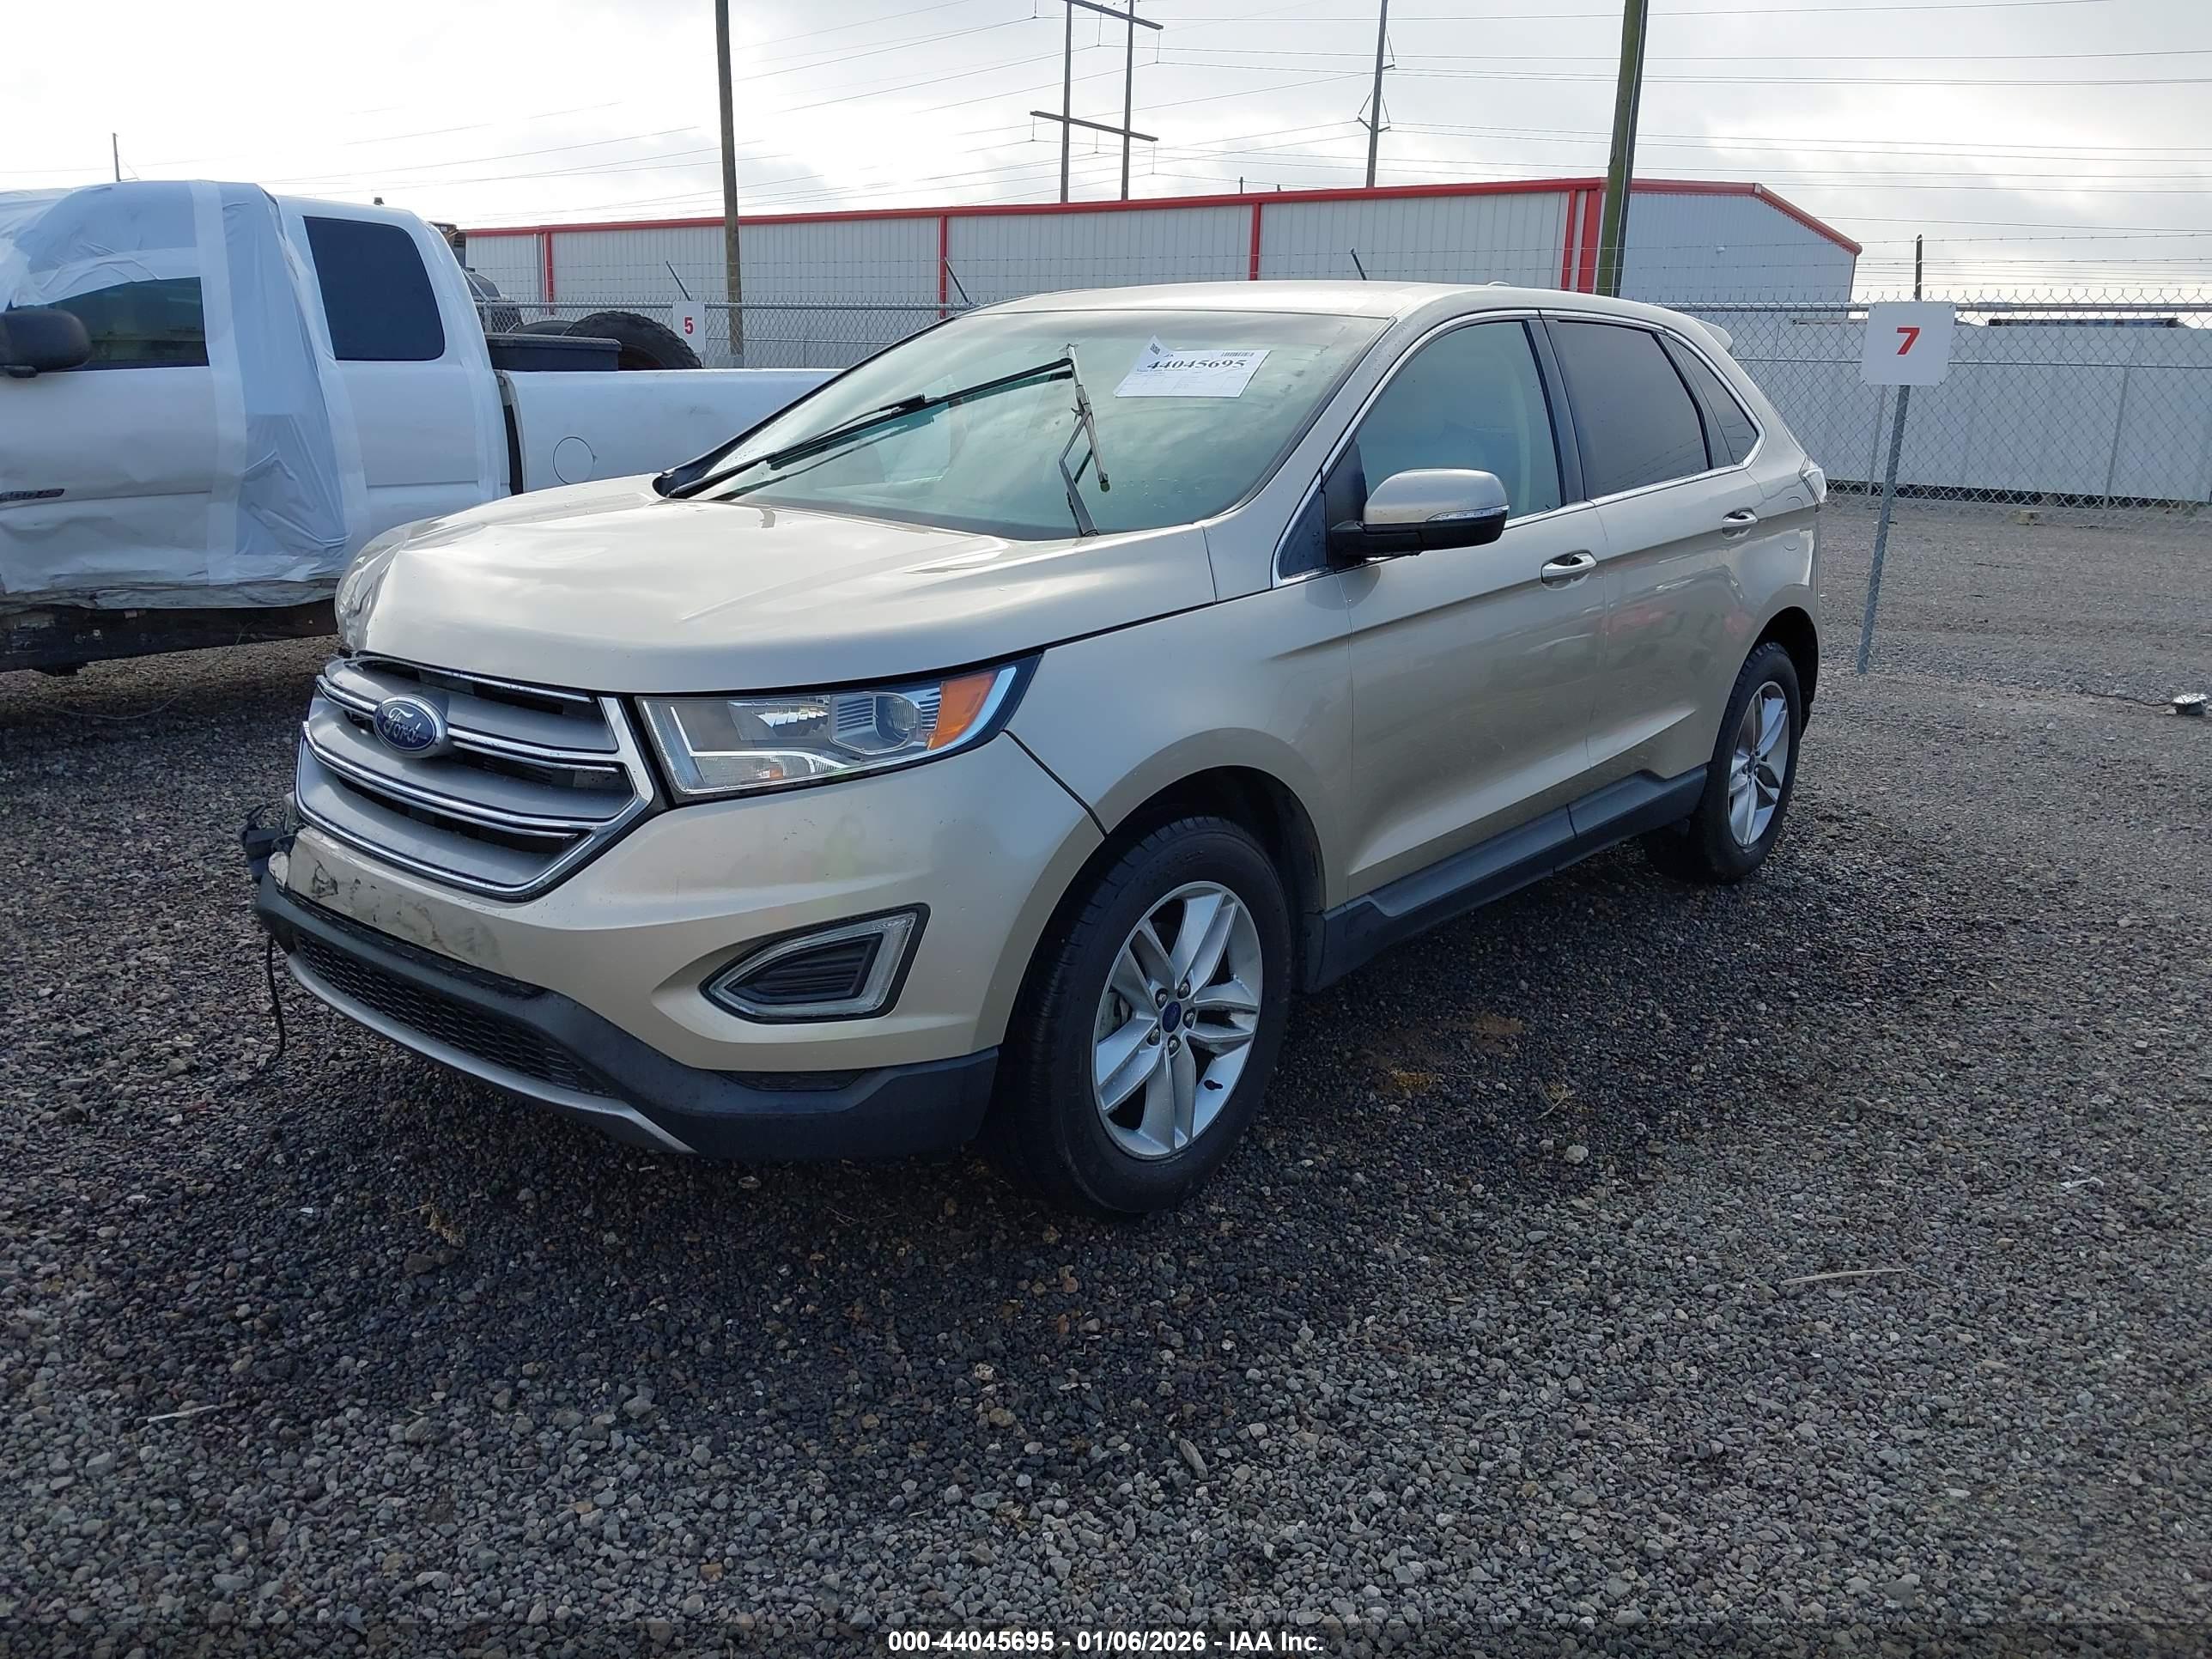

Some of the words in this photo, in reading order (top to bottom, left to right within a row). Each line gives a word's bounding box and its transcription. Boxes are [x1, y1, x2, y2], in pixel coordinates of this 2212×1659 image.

[684, 316, 694, 335] 5
[1896, 326, 1921, 356] 7
[1146, 359, 1248, 370] 44045695
[383, 707, 428, 744] Ford
